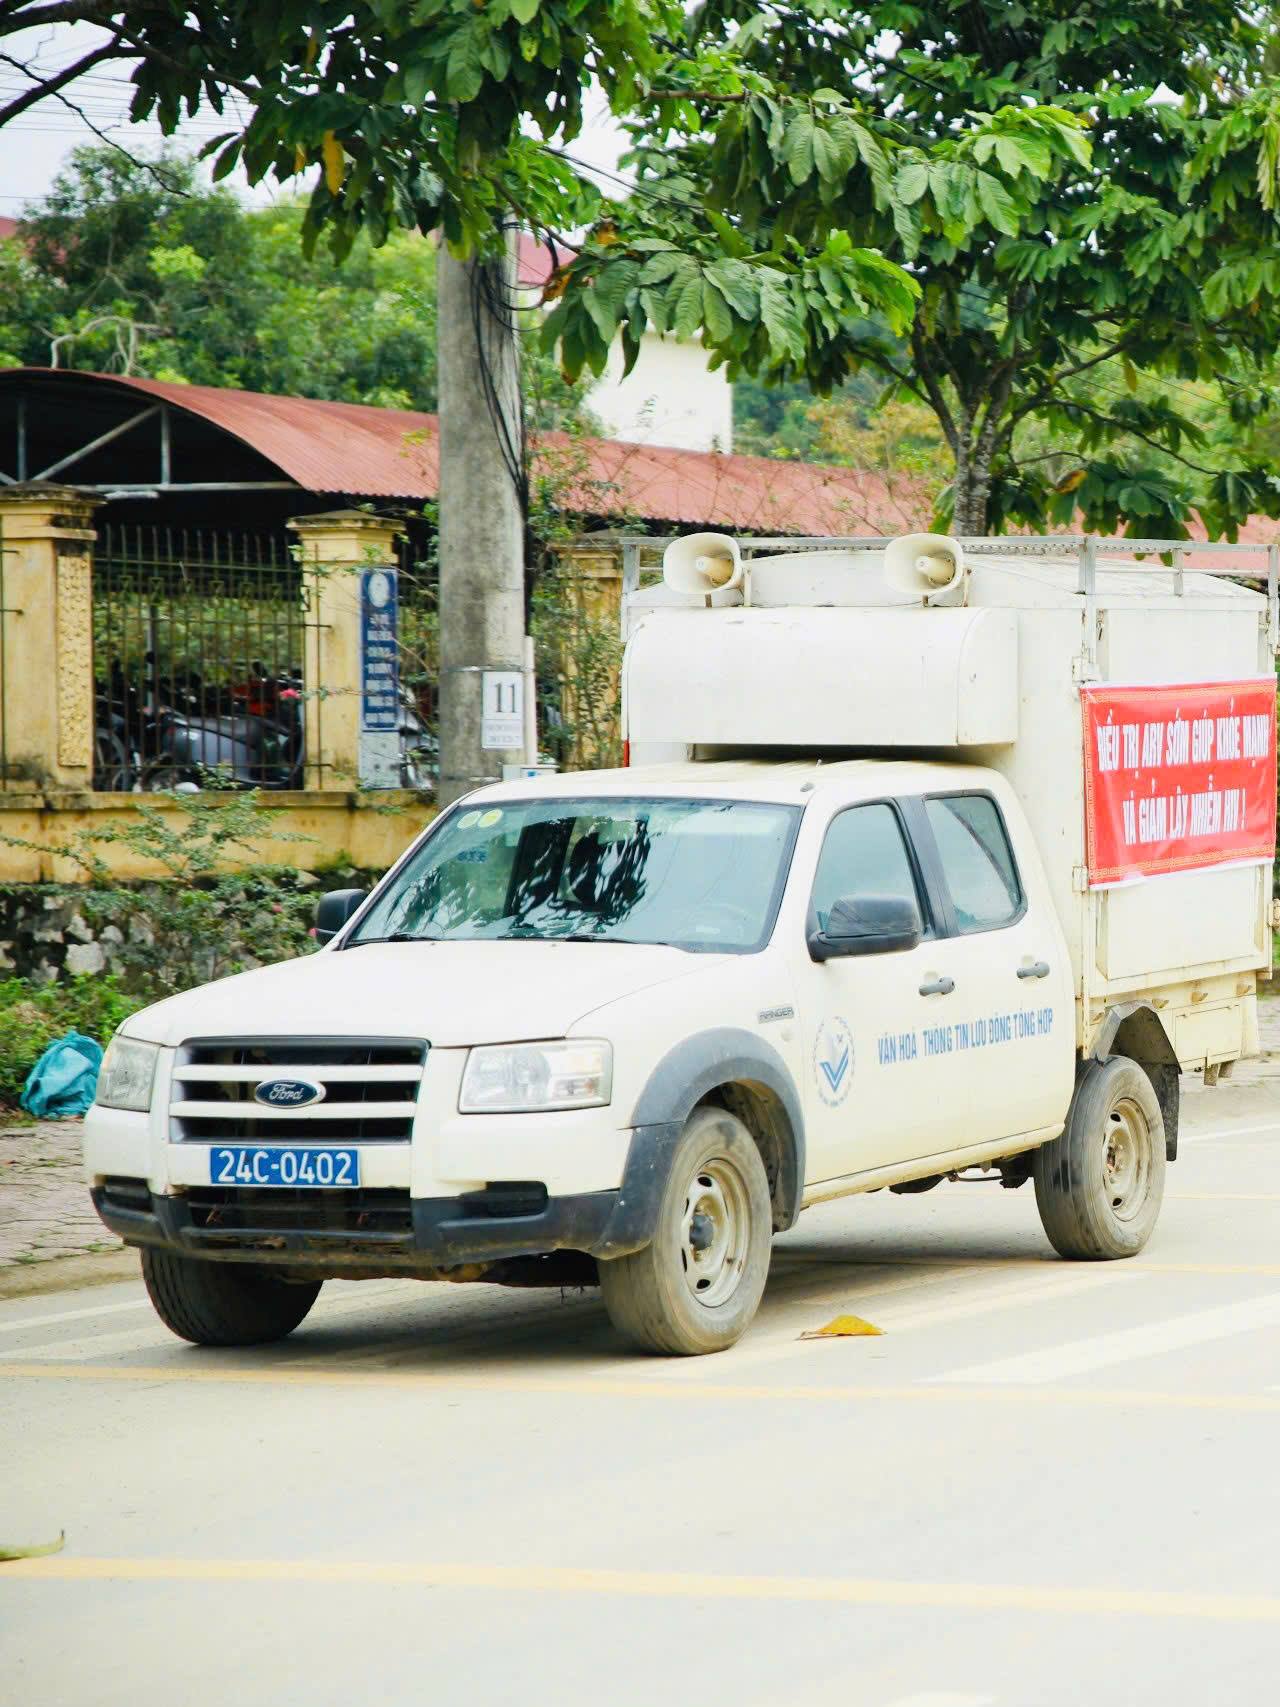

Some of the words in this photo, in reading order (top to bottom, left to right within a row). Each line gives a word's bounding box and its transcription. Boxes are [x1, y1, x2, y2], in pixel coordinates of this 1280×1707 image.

[495, 682, 516, 713] 11
[1141, 721, 1164, 768] ARV
[1191, 709, 1214, 764] GIÚP
[955, 1023, 969, 1050] TIN
[269, 1083, 305, 1101] Ford
[217, 1150, 353, 1185] 24C-0402
